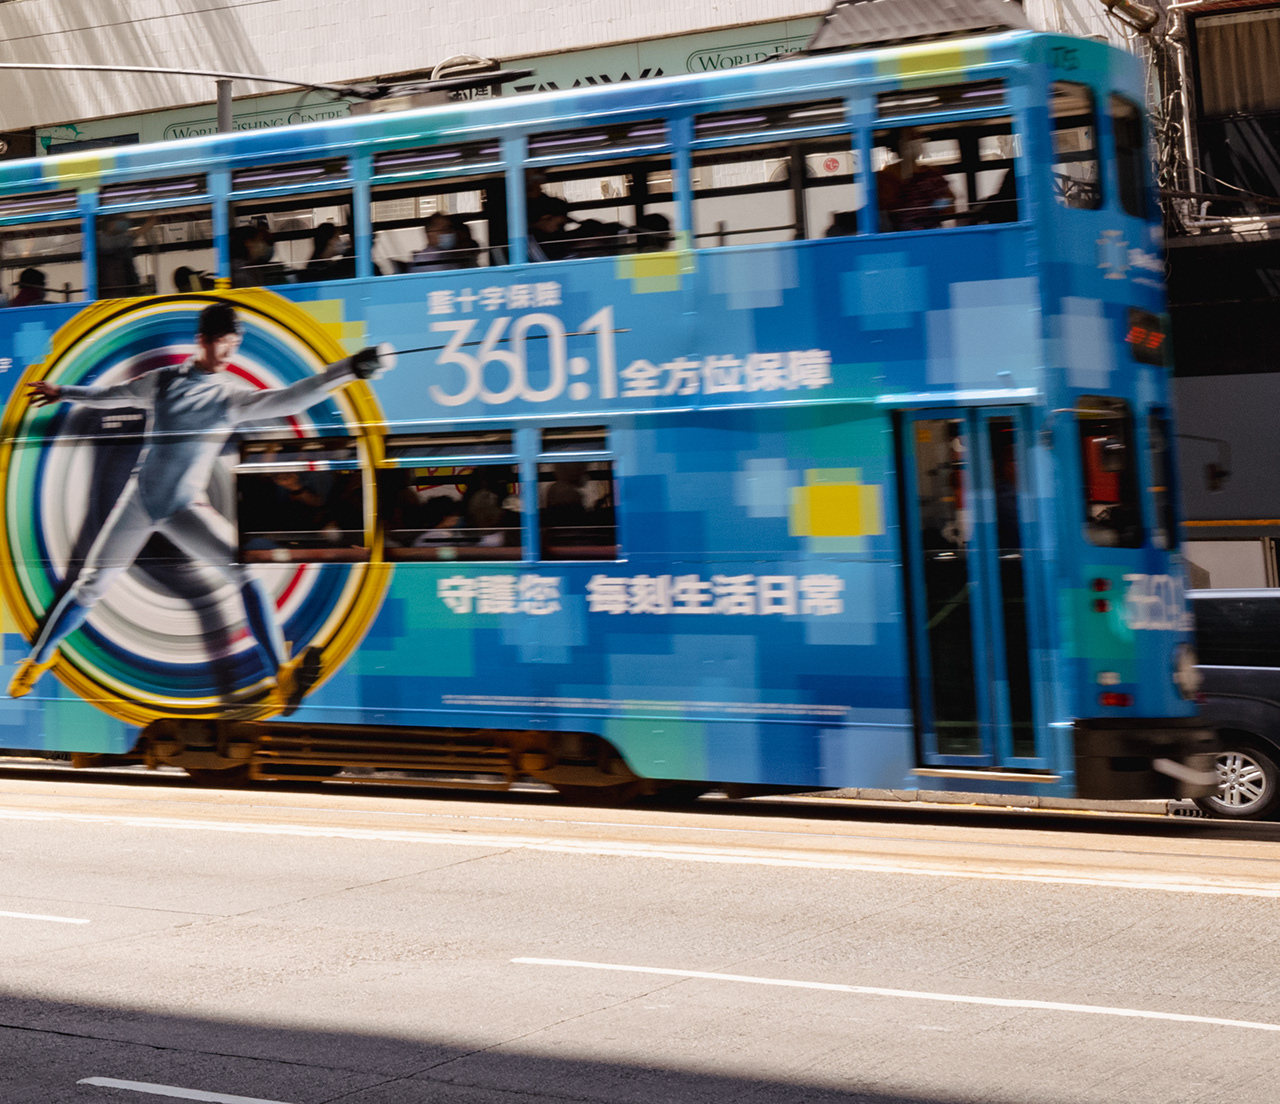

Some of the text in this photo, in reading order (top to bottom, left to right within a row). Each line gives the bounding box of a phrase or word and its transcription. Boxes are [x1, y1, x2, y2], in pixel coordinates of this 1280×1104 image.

[426, 281, 562, 314] 藍十字保險
[427, 306, 833, 407] 360:1 全方位保障
[437, 574, 845, 615] 守護您 每刻生活日常
